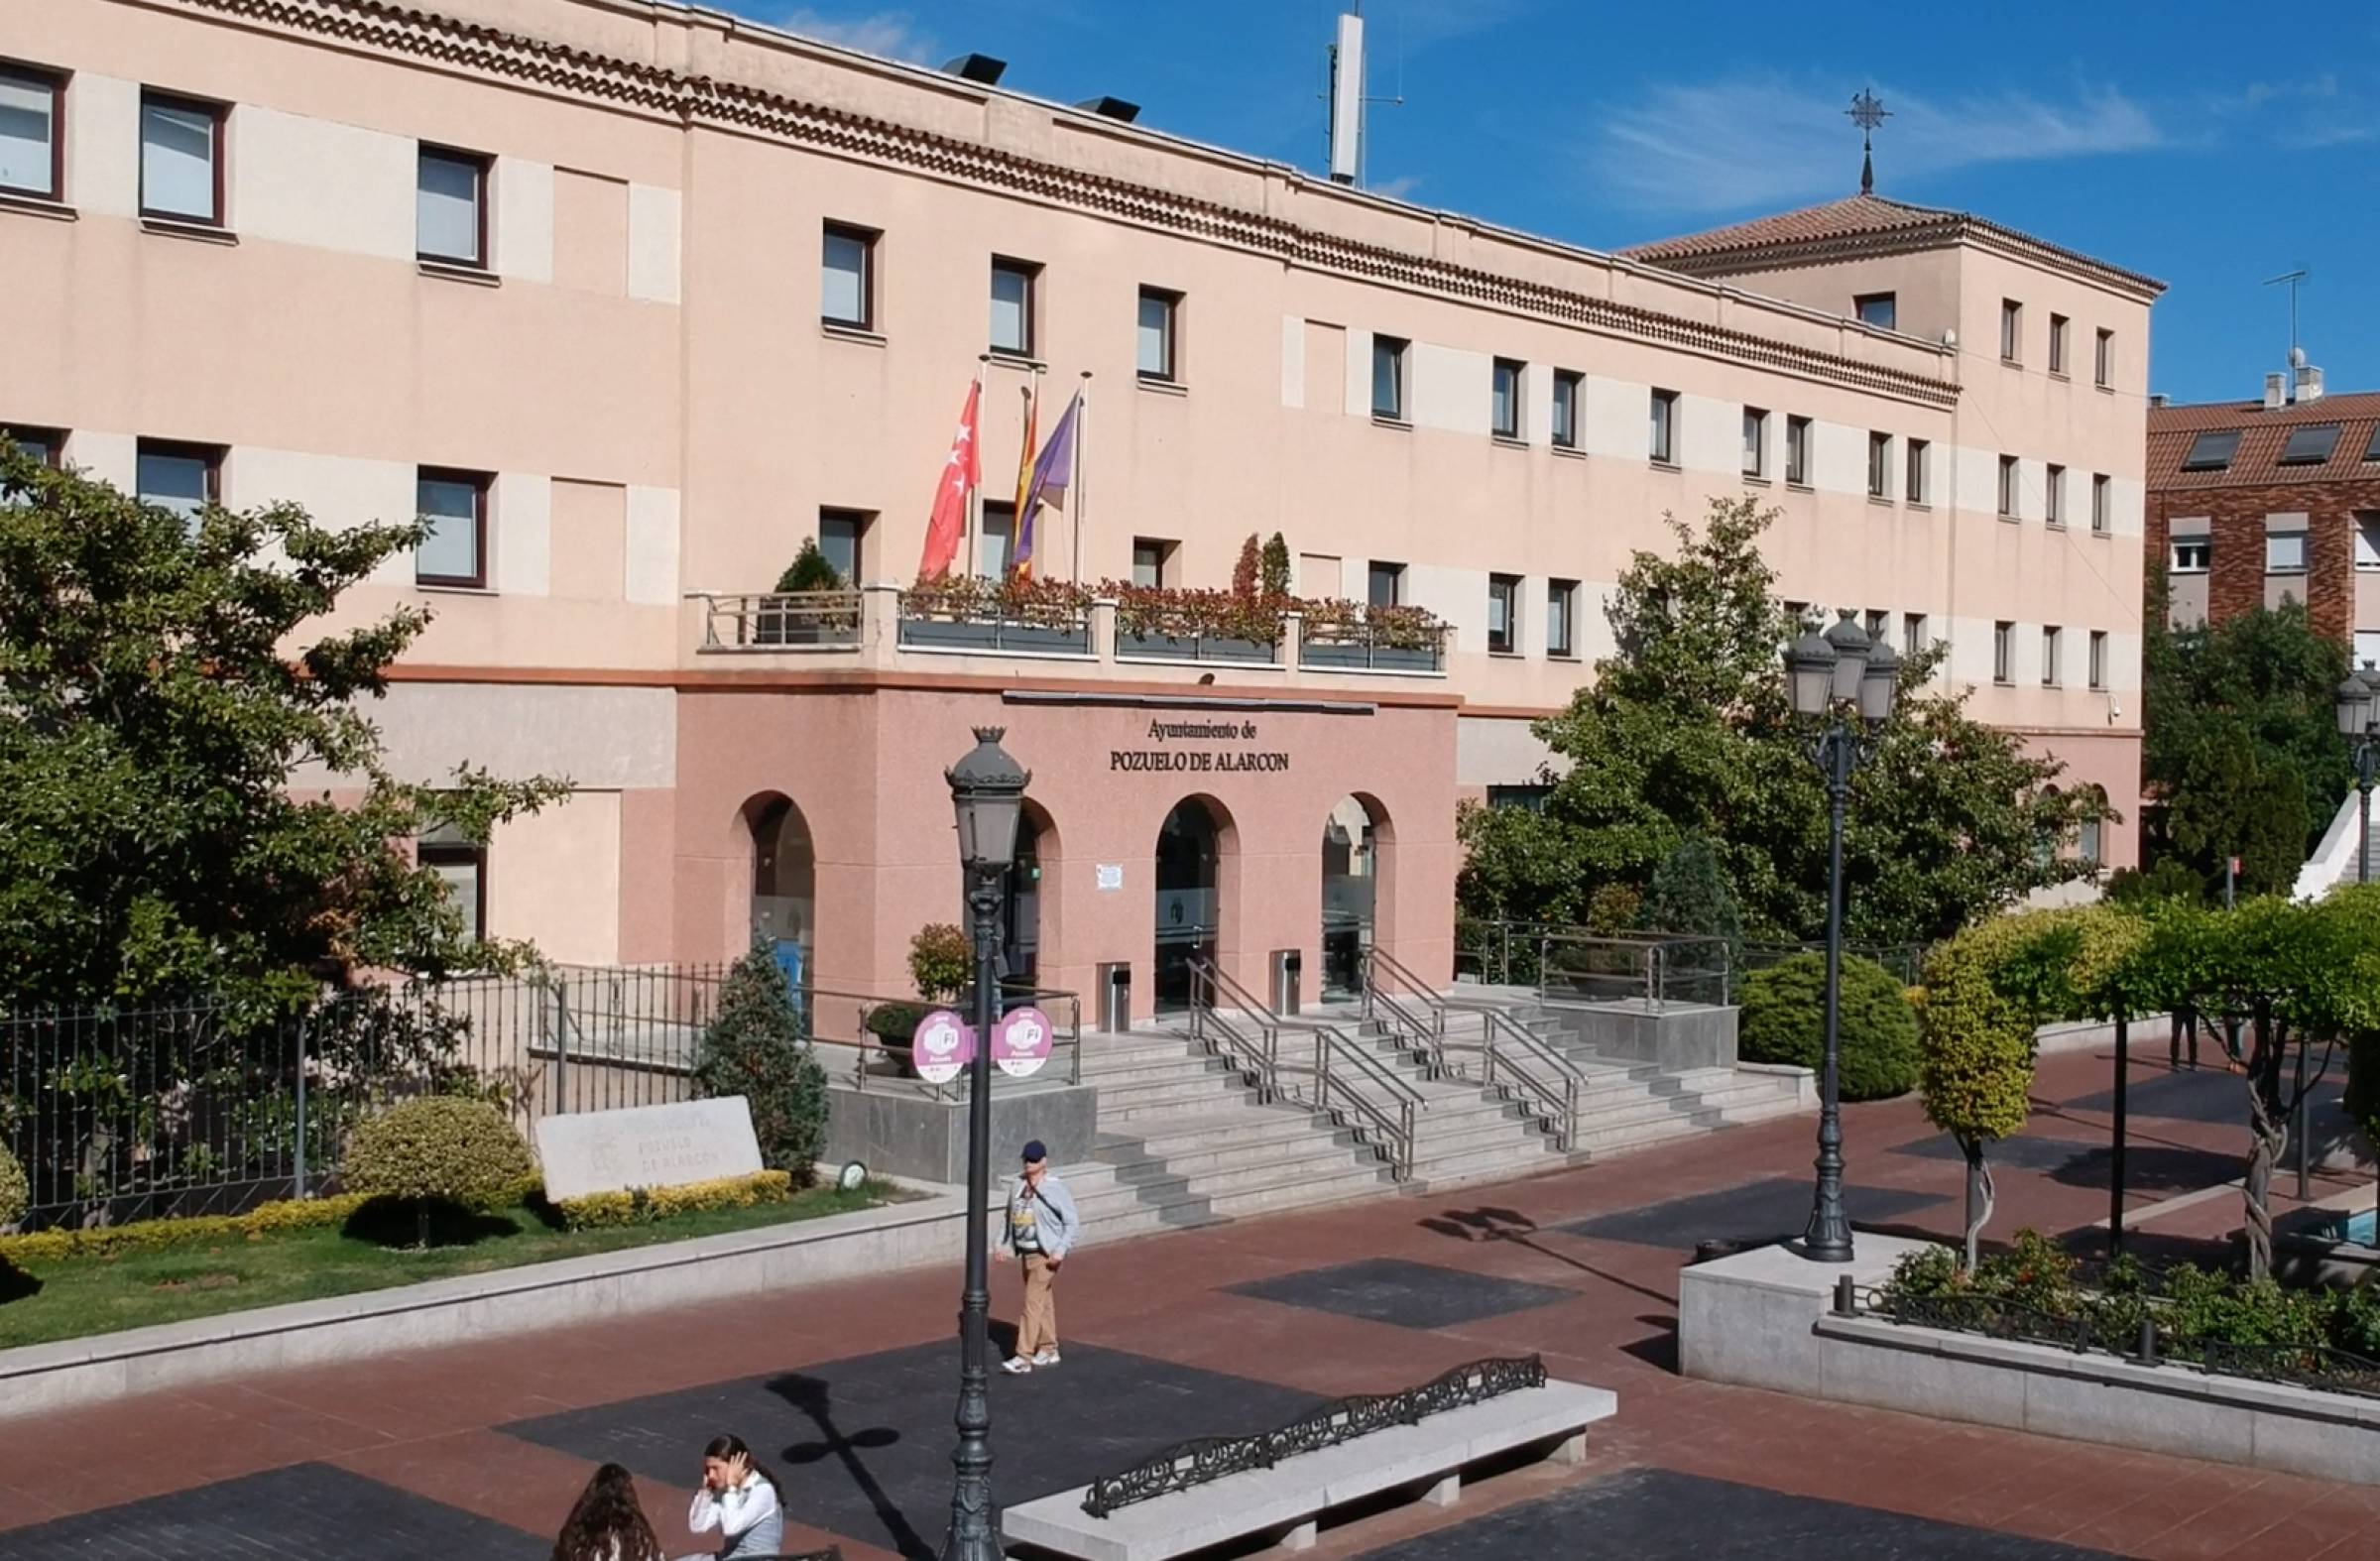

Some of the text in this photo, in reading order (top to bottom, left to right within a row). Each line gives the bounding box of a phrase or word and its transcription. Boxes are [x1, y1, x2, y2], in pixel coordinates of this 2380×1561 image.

[1147, 718, 1256, 742] Ayuntamiento de
[1111, 751, 1289, 772] POZUELO DE ALARCON
